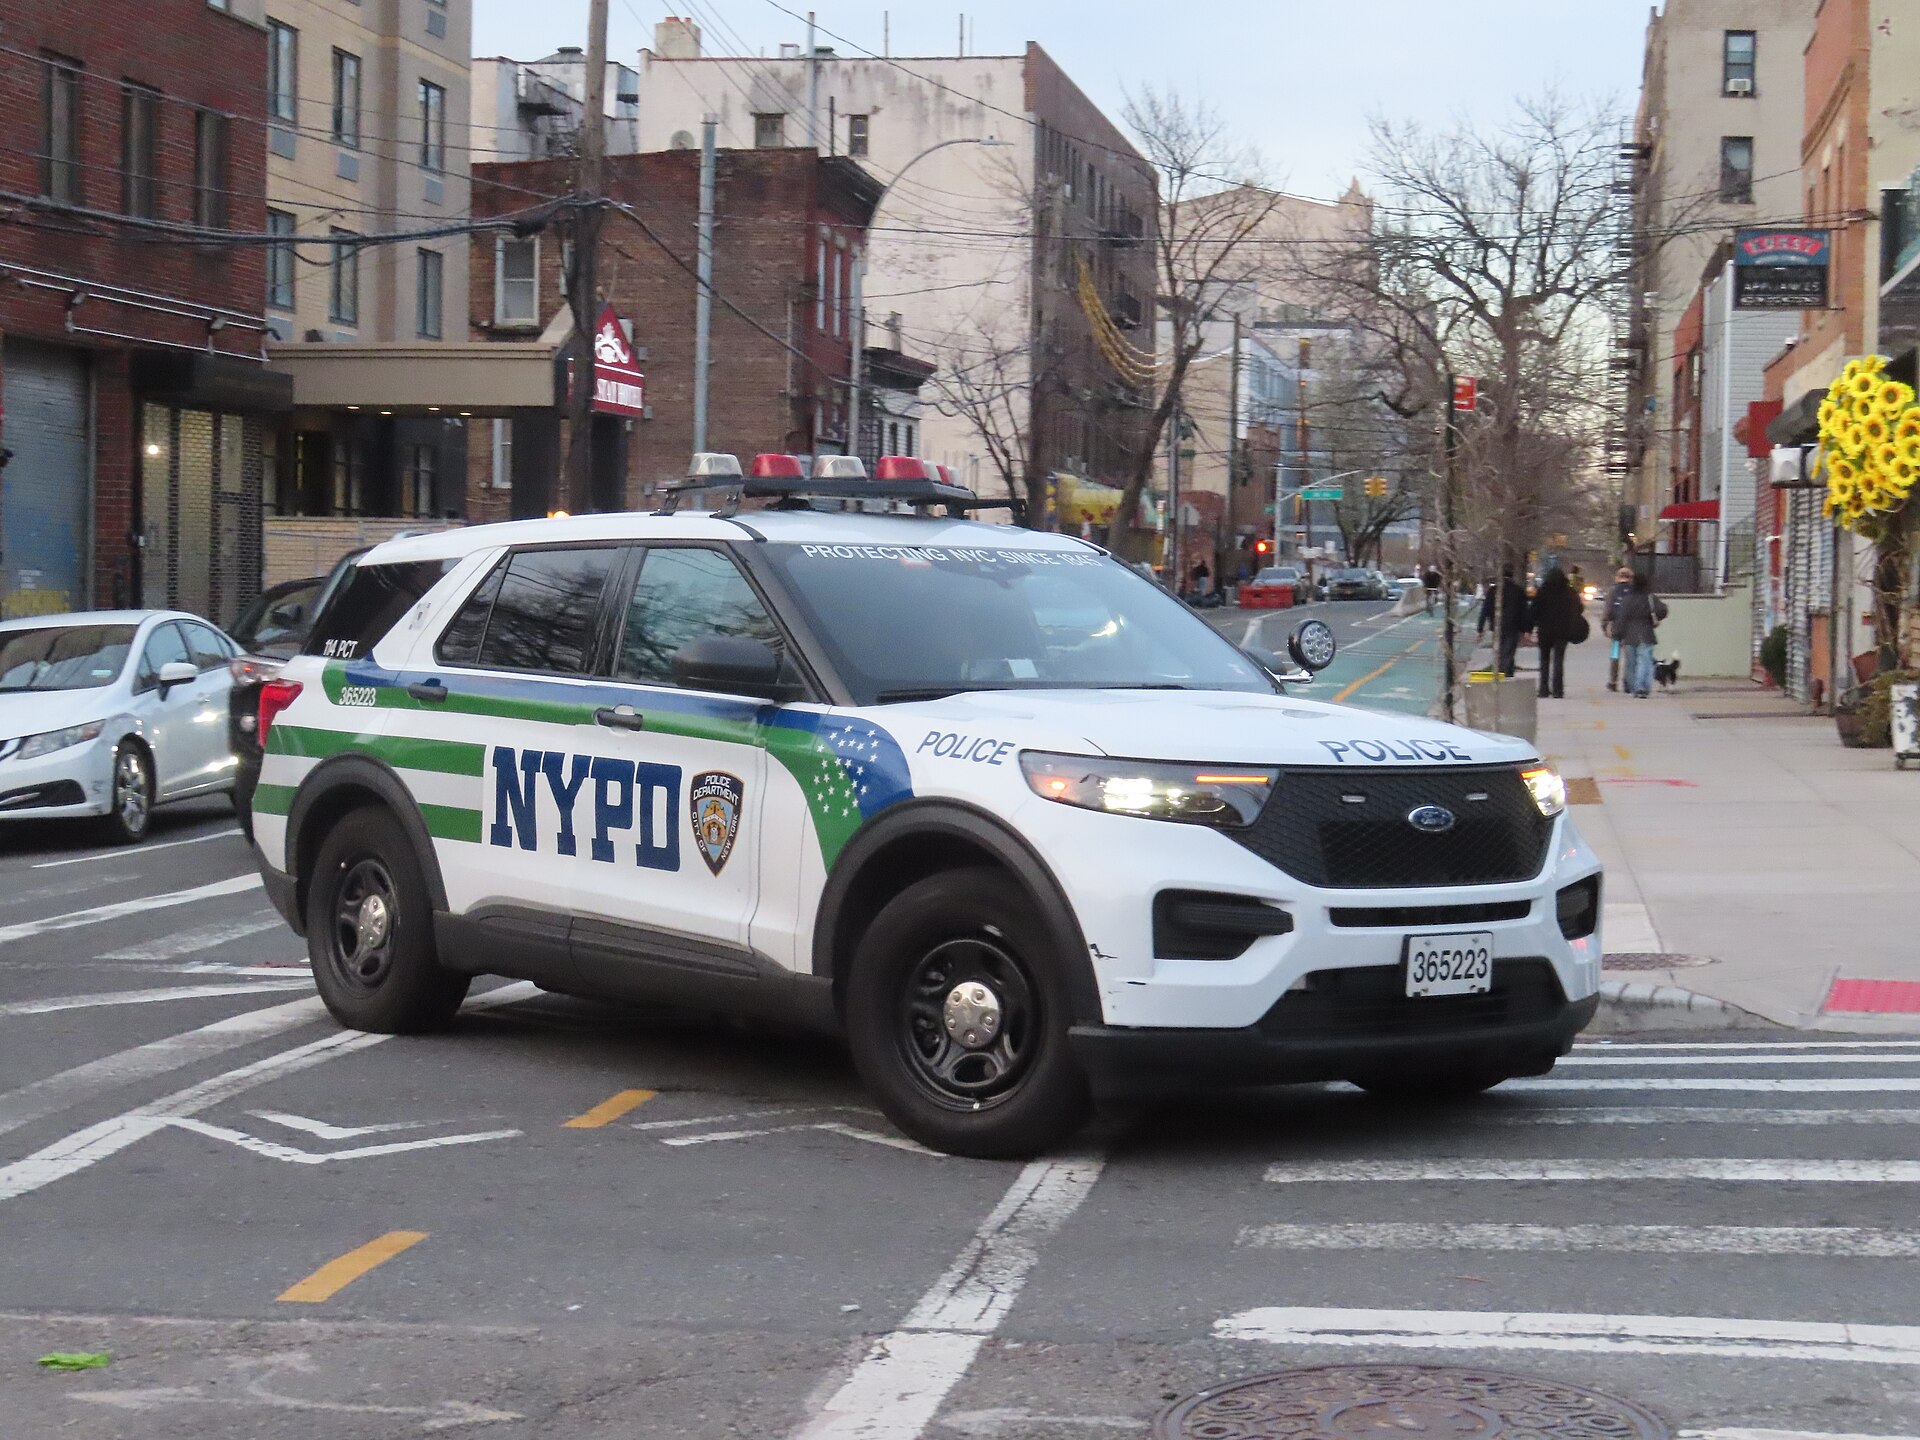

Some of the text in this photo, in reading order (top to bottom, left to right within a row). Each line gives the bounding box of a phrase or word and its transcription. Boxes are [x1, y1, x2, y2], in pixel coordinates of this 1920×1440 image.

[801, 544, 1104, 567] PROTECTING NYC SINCE 1845
[323, 639, 358, 658] 114 PCT
[339, 687, 376, 706] 365223
[916, 730, 1016, 765] POLICE
[1317, 739, 1472, 762] POLICE
[704, 775, 731, 788] POLICE
[693, 785, 739, 805] DEPARTMENT
[490, 745, 682, 871] NYPD
[692, 811, 707, 853] CITY OF
[720, 813, 739, 860] NEW YORK
[1413, 947, 1488, 983] 365223
